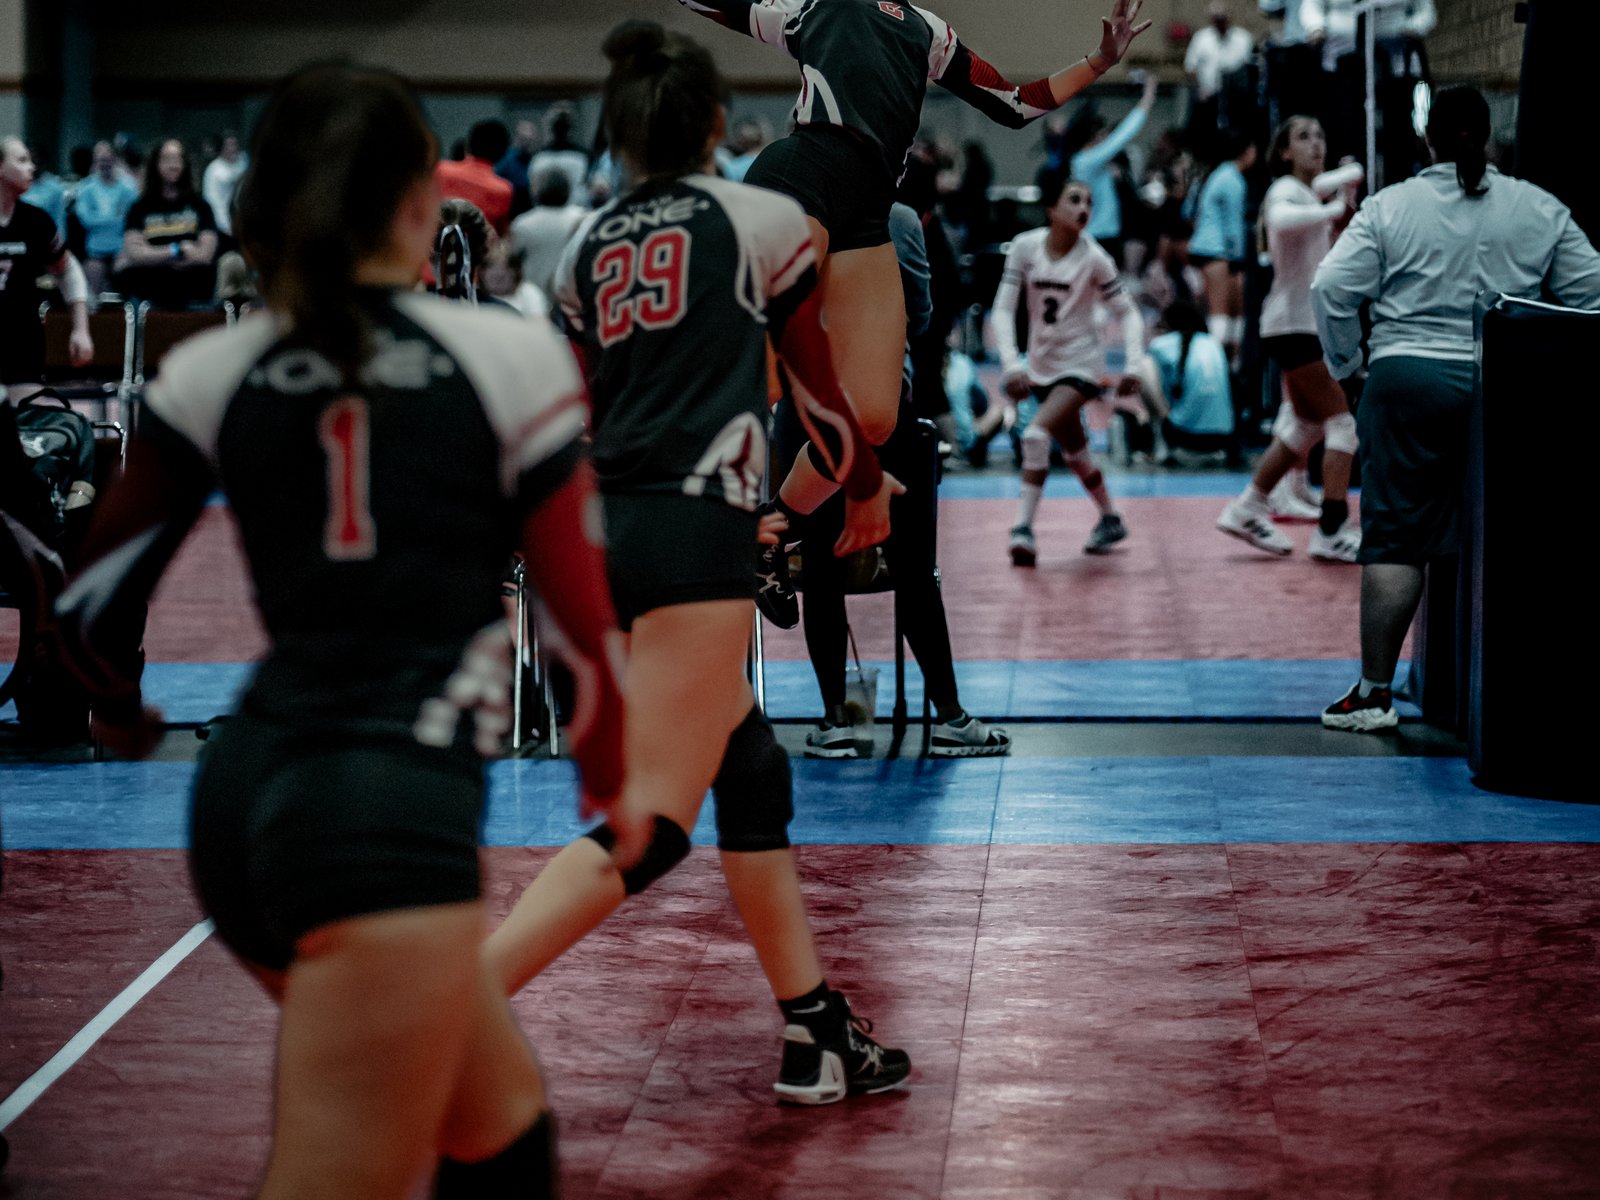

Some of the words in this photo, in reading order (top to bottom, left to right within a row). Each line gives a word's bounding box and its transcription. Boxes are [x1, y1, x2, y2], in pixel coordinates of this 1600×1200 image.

[598, 196, 697, 241] ONE
[591, 225, 692, 349] 29
[1044, 298, 1058, 324] 2
[315, 393, 379, 562] 1
